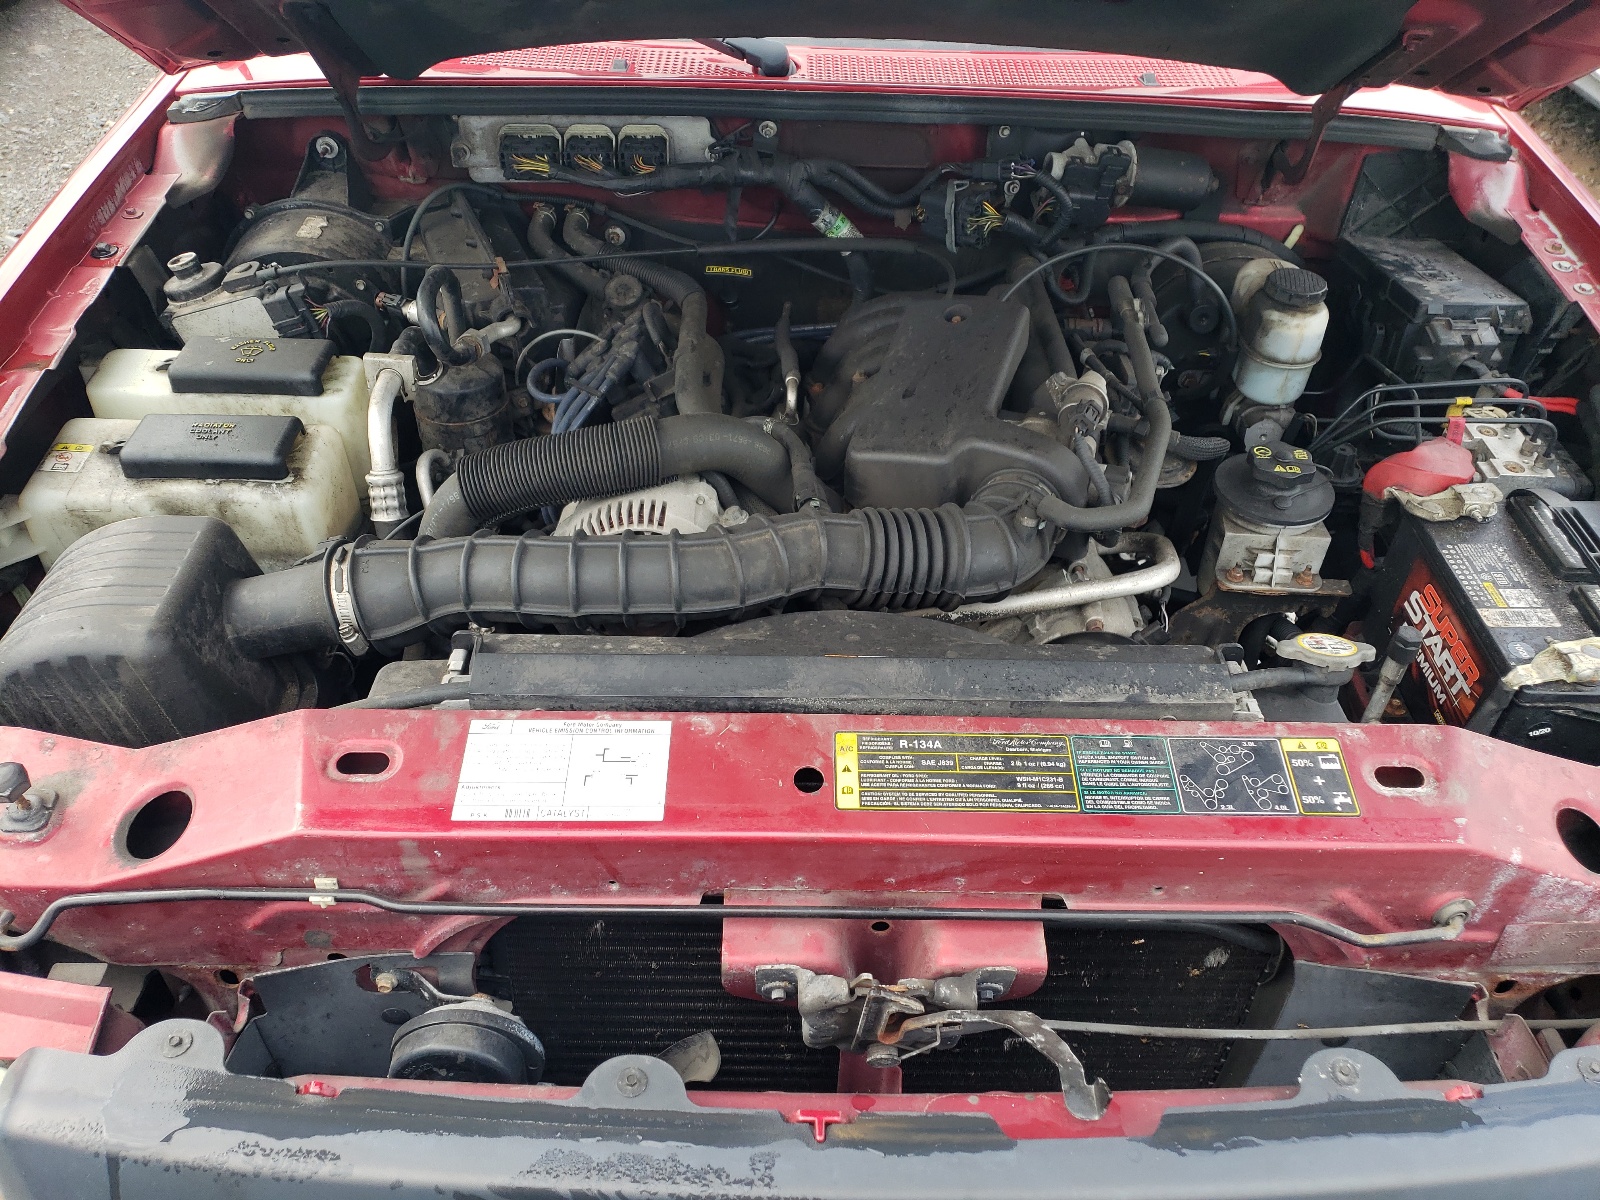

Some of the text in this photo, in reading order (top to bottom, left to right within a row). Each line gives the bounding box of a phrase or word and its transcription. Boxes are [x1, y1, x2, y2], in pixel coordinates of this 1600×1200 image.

[1419, 583, 1480, 688] SUPER
[1403, 590, 1471, 696] START
[839, 745, 854, 753] A/C
[899, 739, 943, 749] R-134A
[992, 738, 1009, 746] Ford
[1030, 738, 1066, 749] Company
[1291, 758, 1314, 768] 50%
[1302, 794, 1325, 805] 50%
